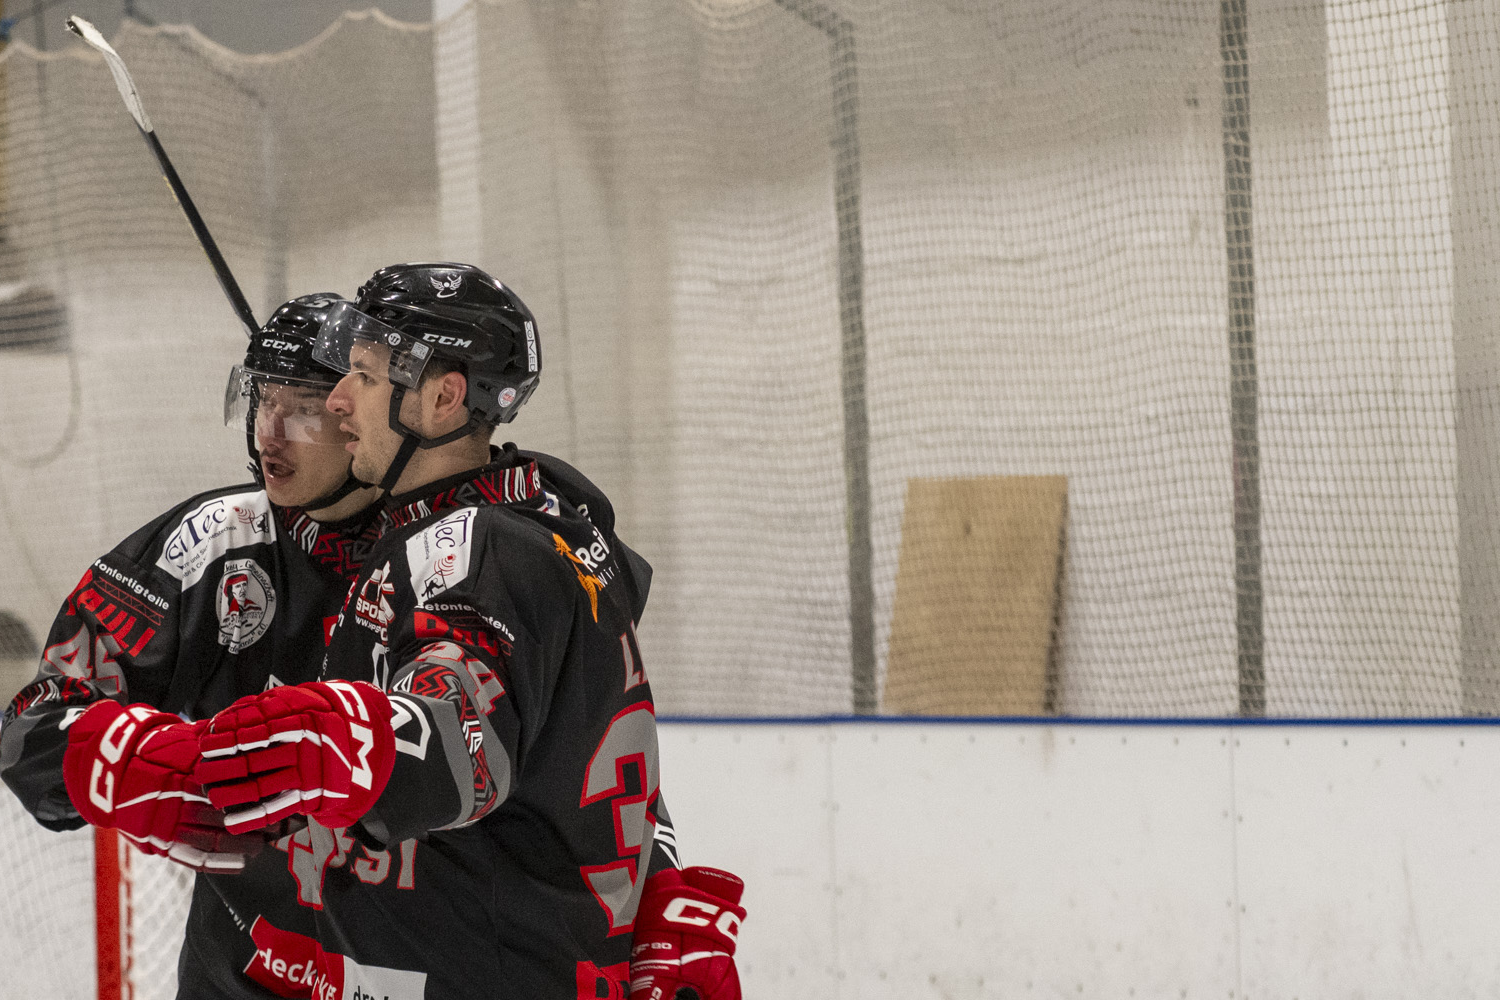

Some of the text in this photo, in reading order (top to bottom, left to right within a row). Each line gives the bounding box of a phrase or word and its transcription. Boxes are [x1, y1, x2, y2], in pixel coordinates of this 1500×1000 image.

[262, 338, 301, 353] CCM
[422, 332, 473, 348] CCM
[94, 559, 169, 611] tonfertigteile
[326, 682, 374, 791] CM
[663, 897, 742, 944] CC
[259, 948, 317, 987] deck
